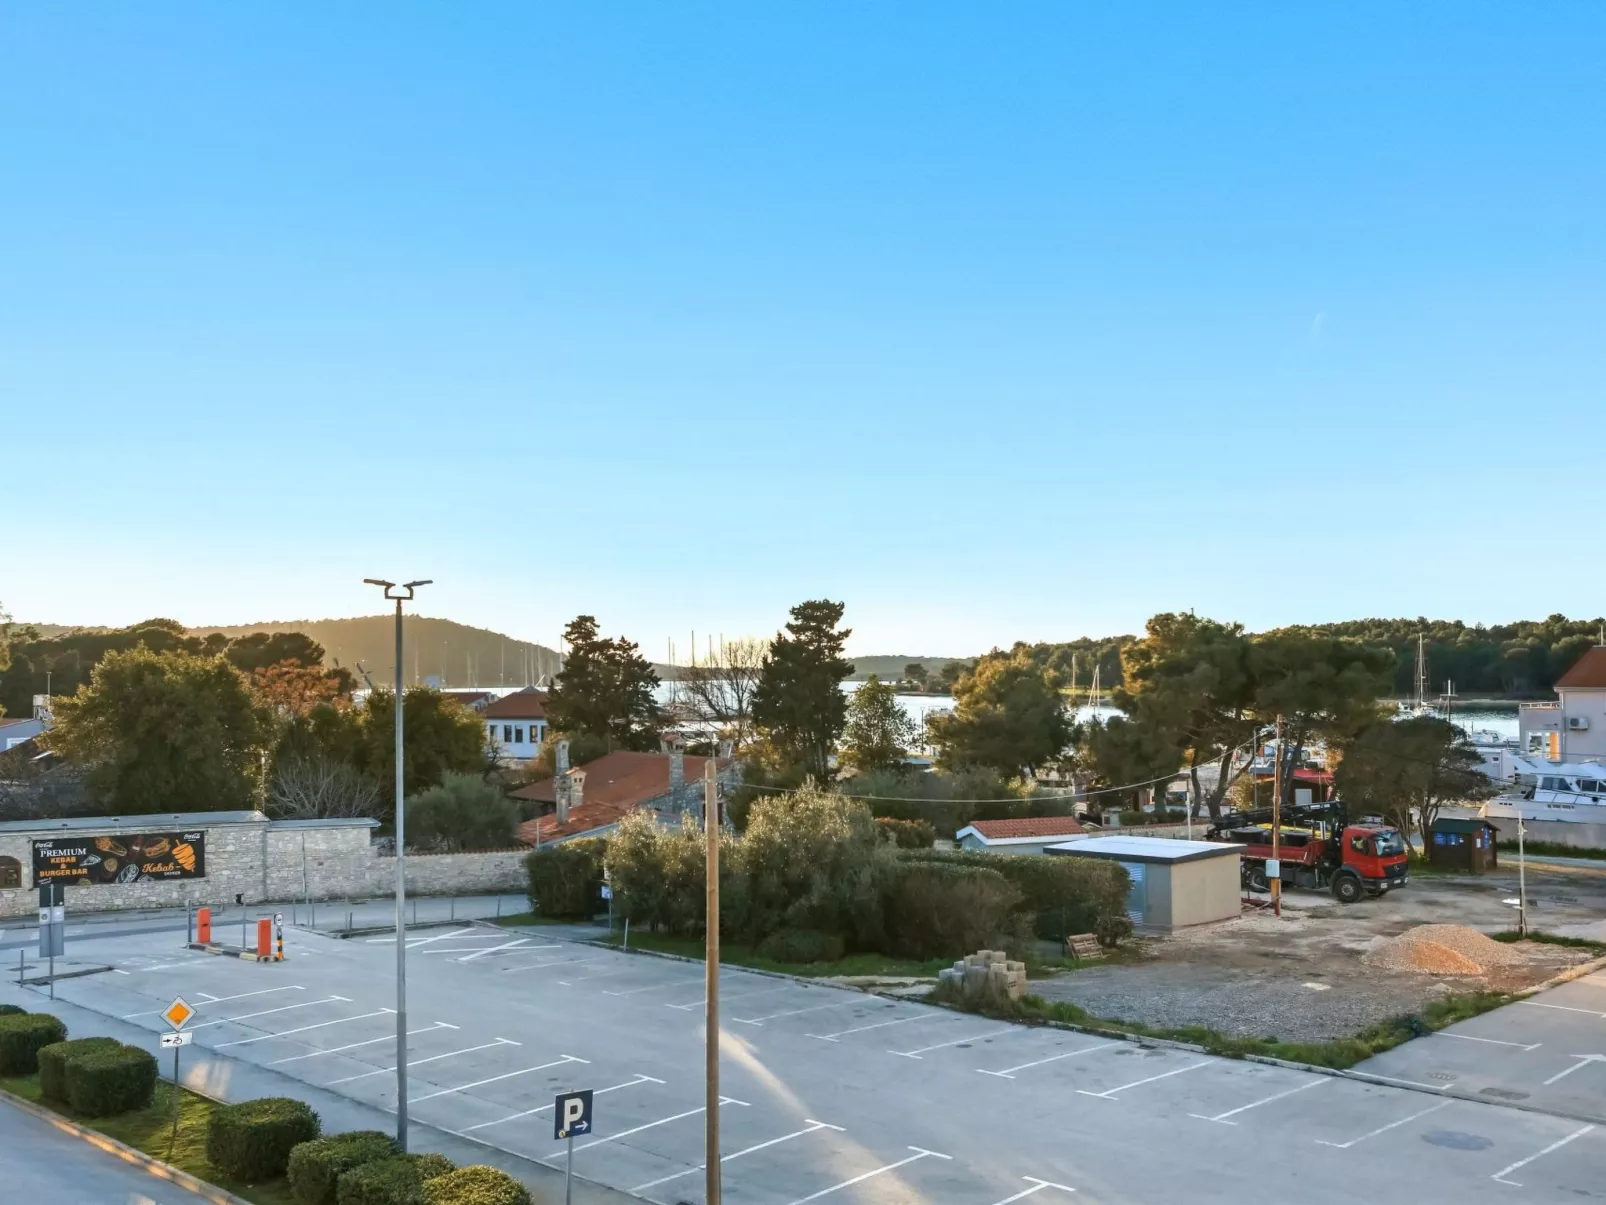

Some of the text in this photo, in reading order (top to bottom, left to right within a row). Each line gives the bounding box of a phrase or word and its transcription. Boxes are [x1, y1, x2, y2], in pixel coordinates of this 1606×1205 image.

[40, 848, 87, 857] PREMIUM
[50, 856, 76, 864] KEBAB
[39, 869, 71, 877] BURGER
[563, 1098, 584, 1131] P
